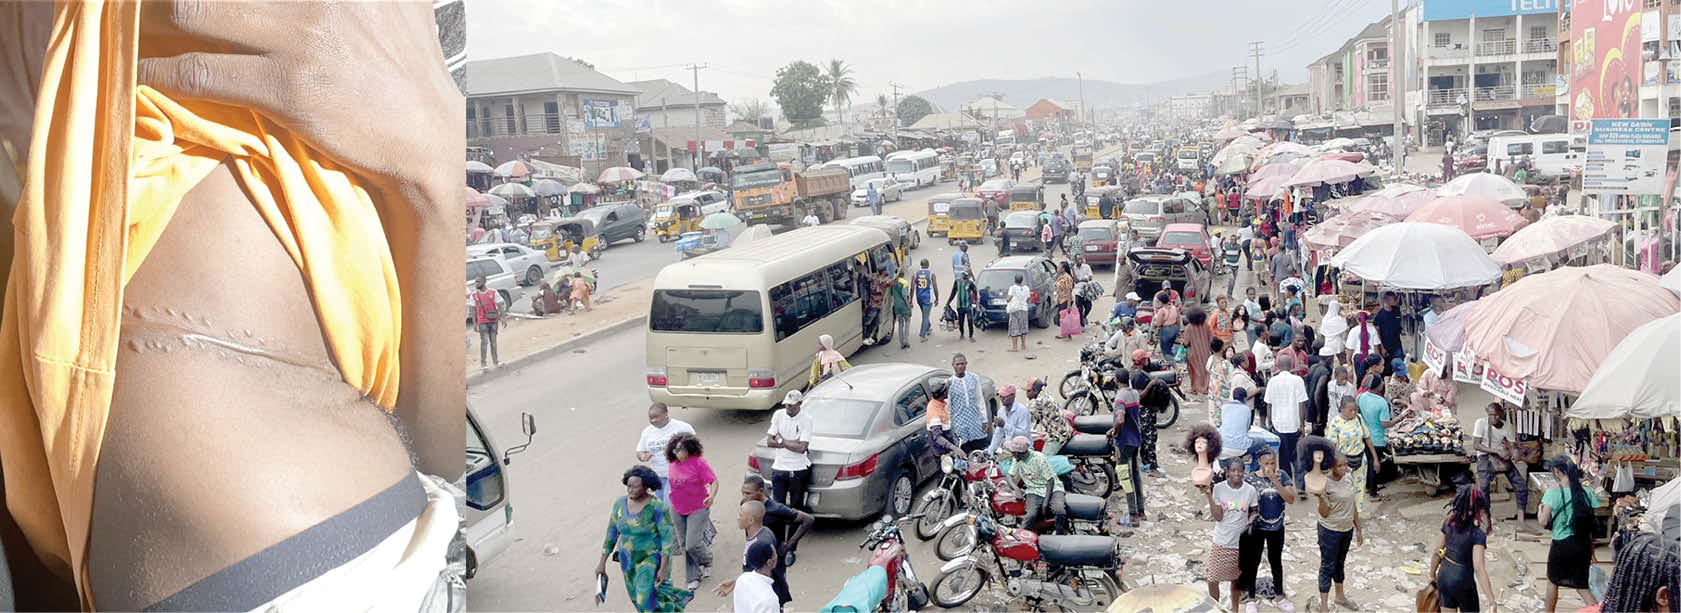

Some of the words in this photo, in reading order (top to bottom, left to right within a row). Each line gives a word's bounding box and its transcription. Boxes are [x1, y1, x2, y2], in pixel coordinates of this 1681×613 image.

[917, 278, 928, 289] 30
[1426, 342, 1444, 366] POS
[1486, 367, 1525, 395] POS
